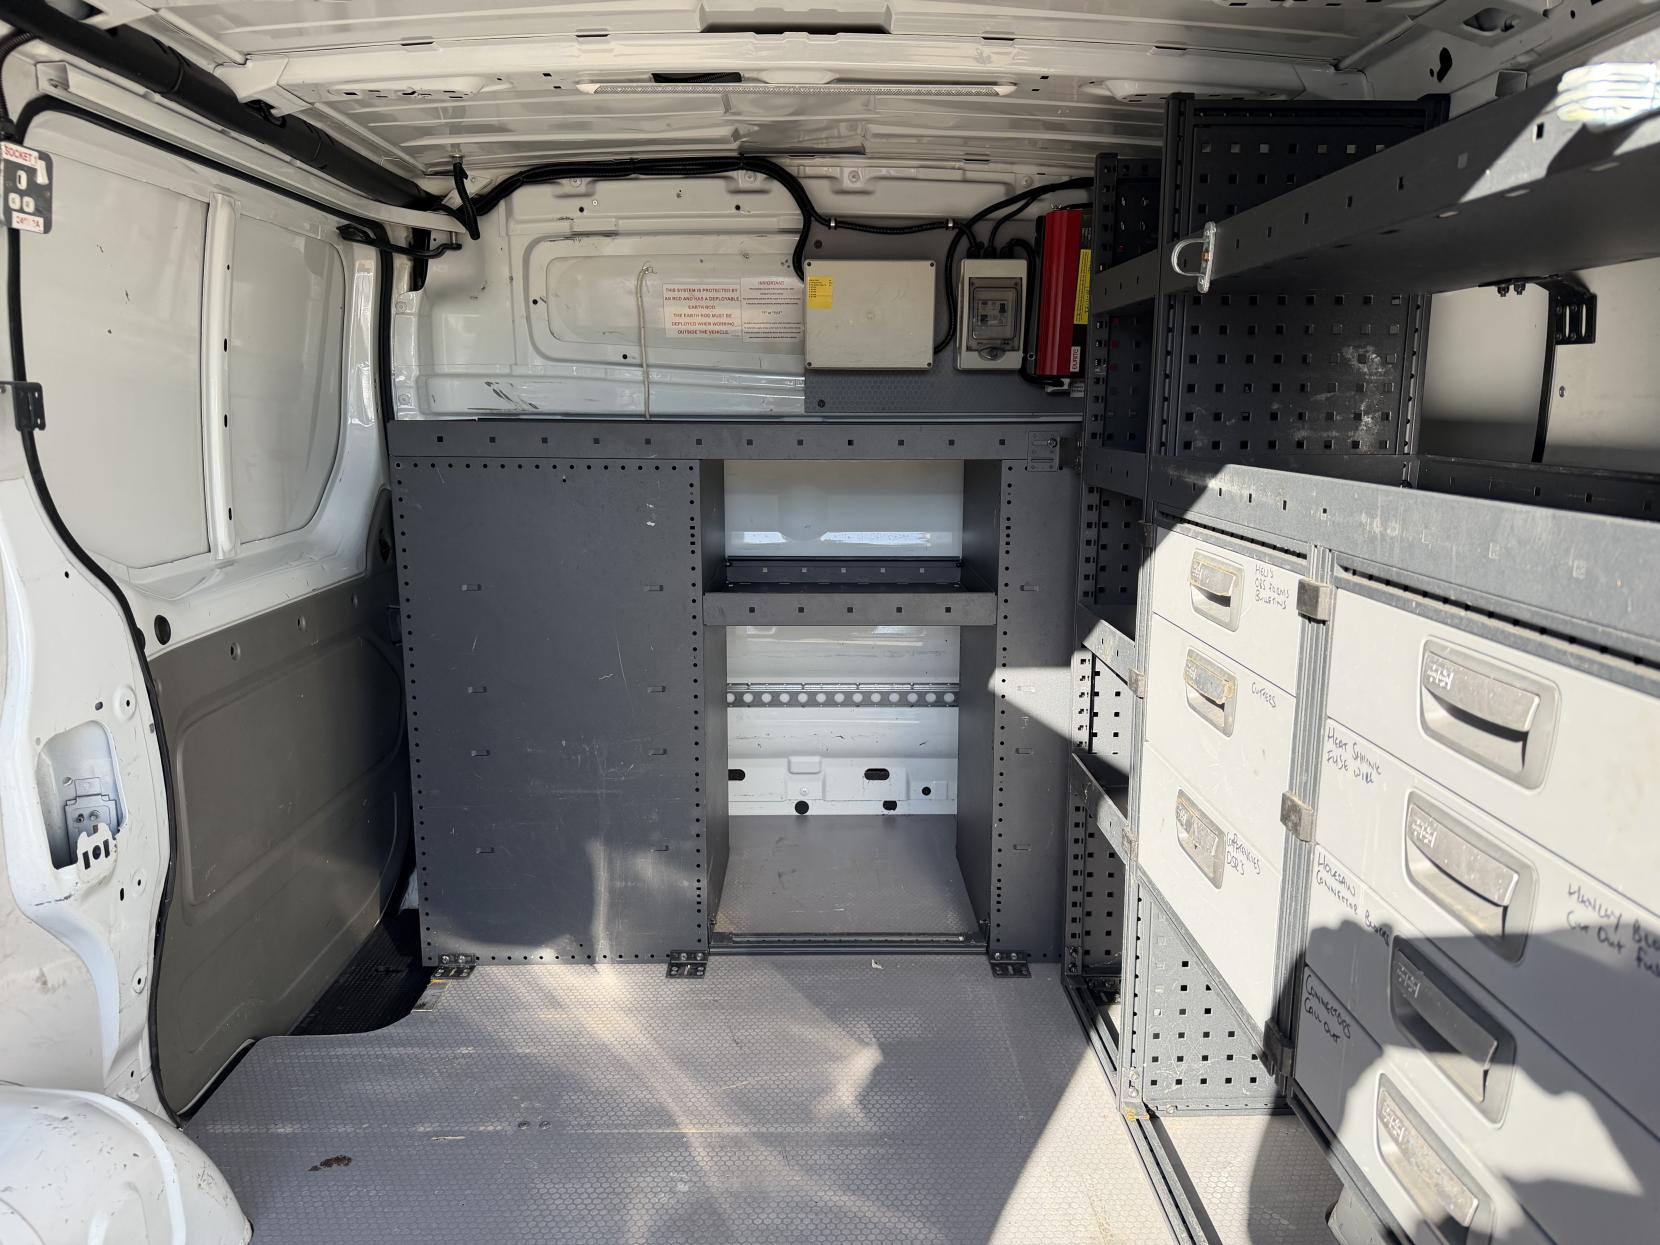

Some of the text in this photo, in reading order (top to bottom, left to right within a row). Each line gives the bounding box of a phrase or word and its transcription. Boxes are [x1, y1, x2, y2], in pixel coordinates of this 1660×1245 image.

[4, 144, 32, 161] SOCKET
[1327, 726, 1349, 752] HEAT
[1327, 750, 1349, 772] FUSE
